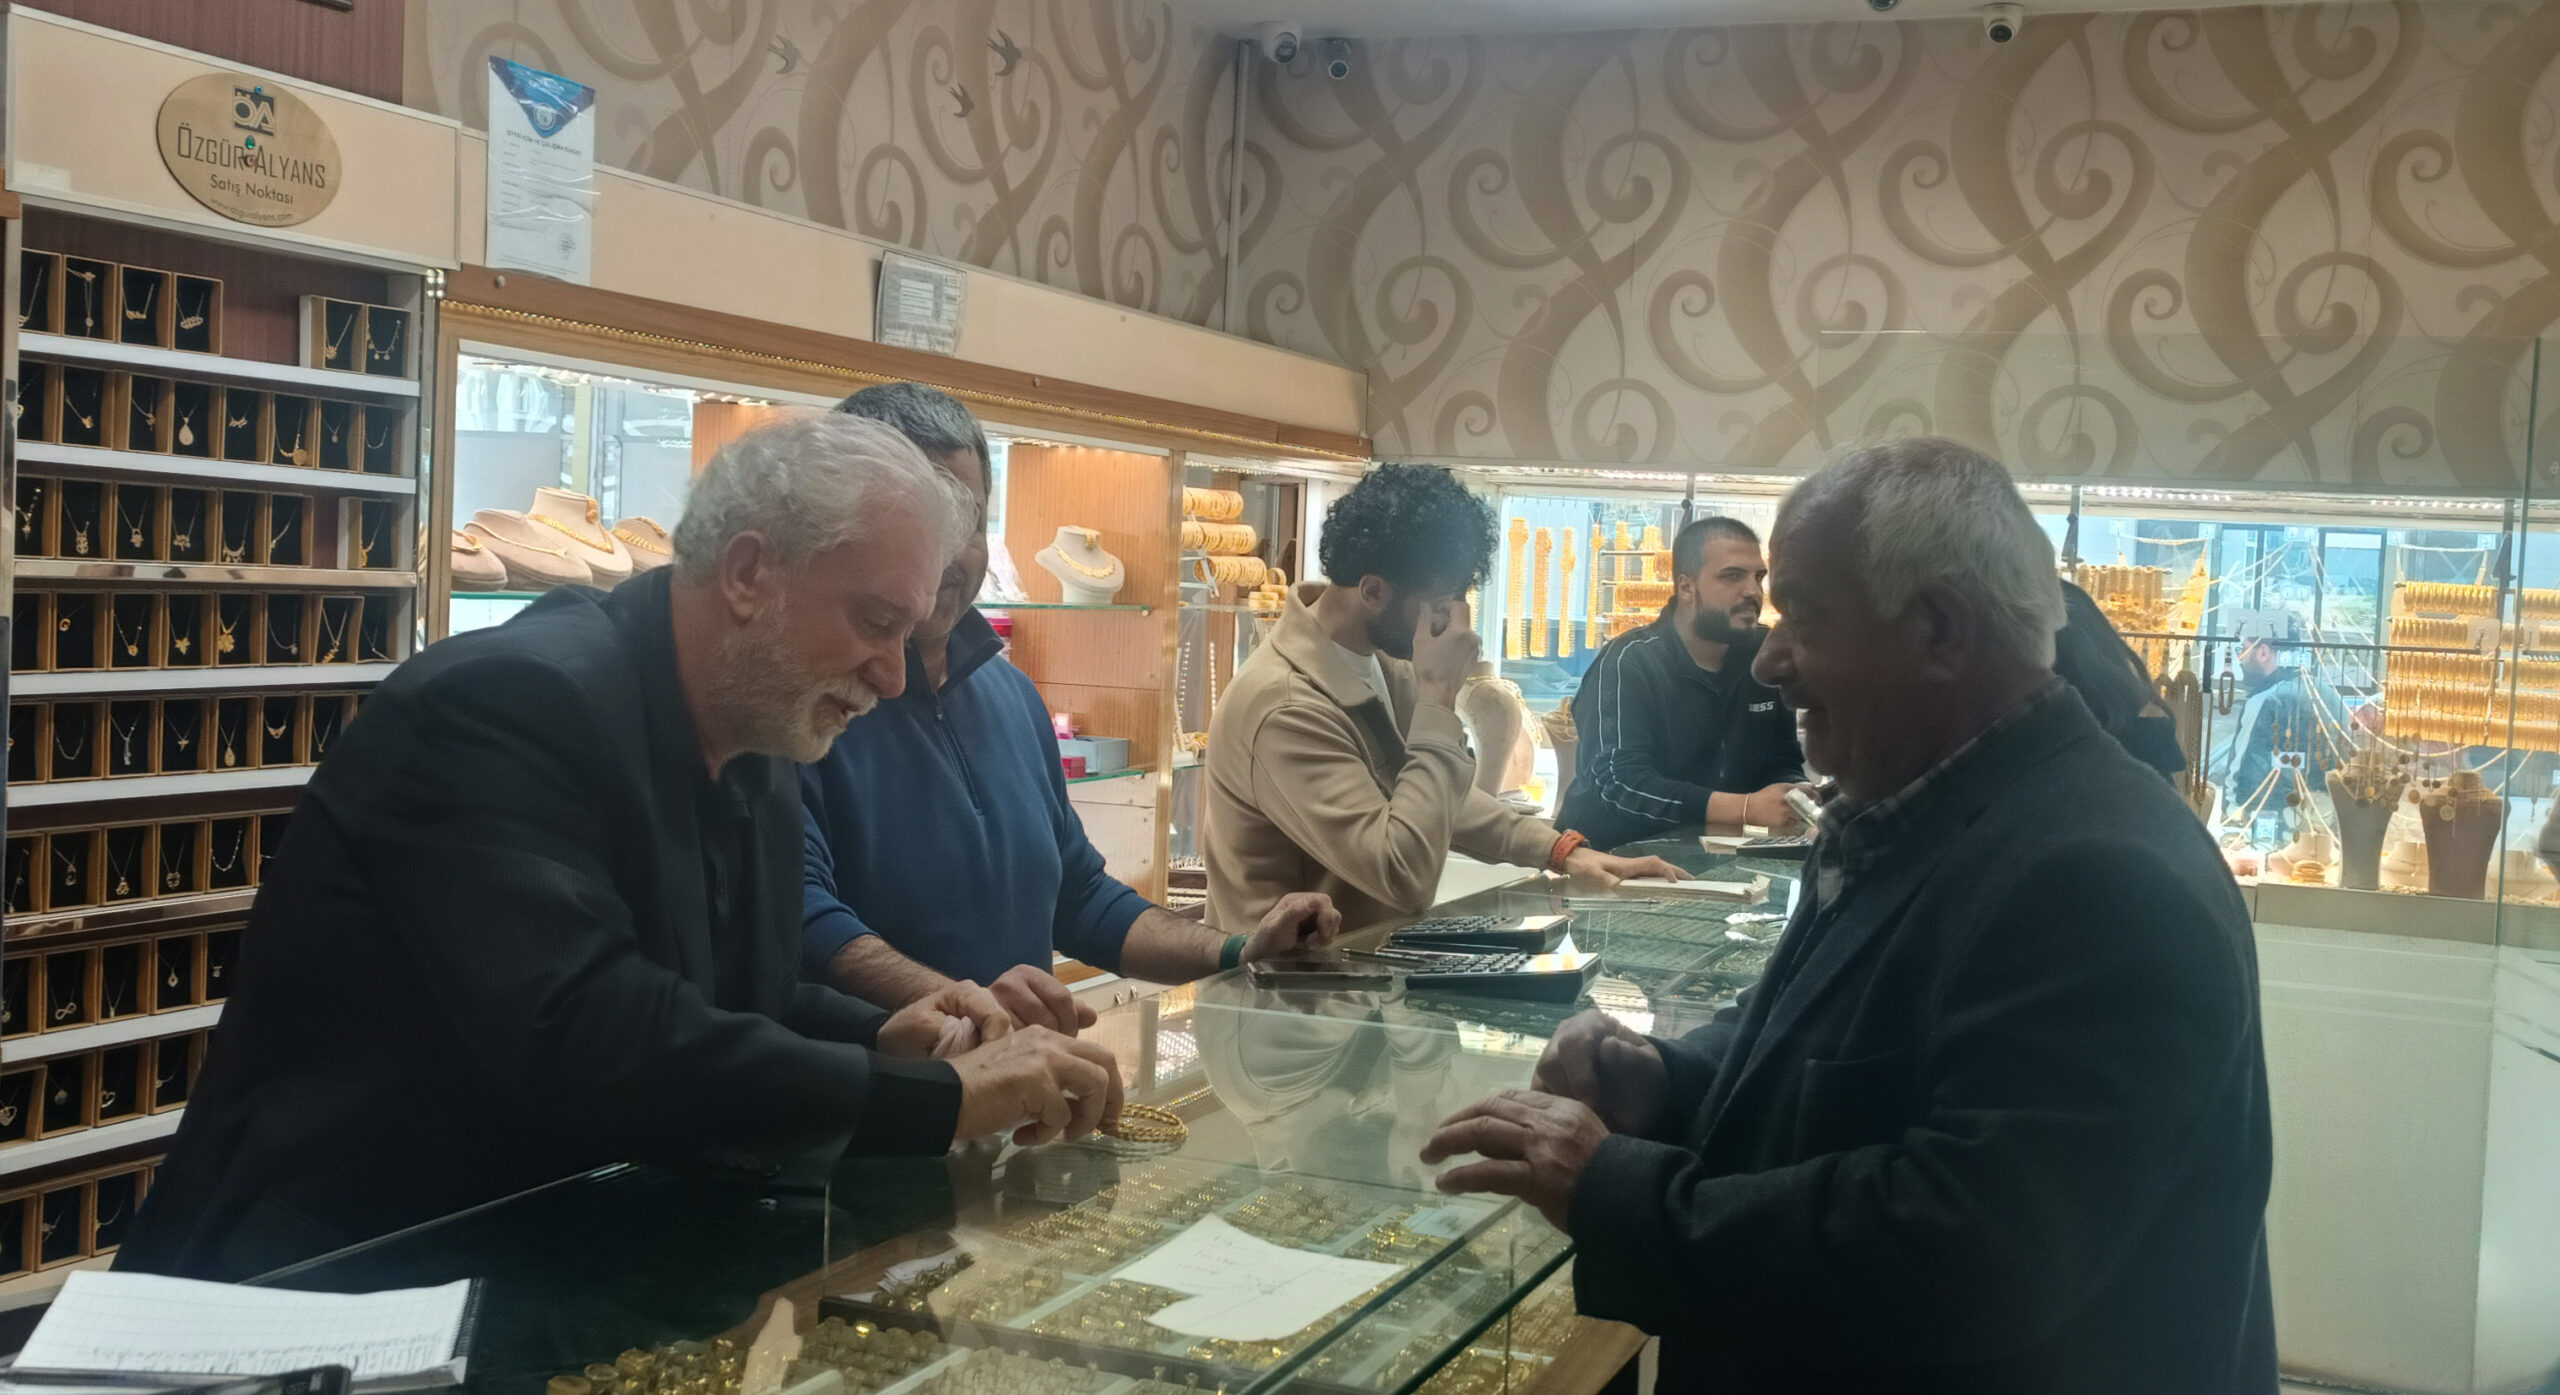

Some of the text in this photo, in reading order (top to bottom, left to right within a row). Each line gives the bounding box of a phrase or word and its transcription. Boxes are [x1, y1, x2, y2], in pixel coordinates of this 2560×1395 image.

[178, 122, 326, 189] ÖZGÜR ALYANS
[210, 174, 293, 205] Satış Noktası
